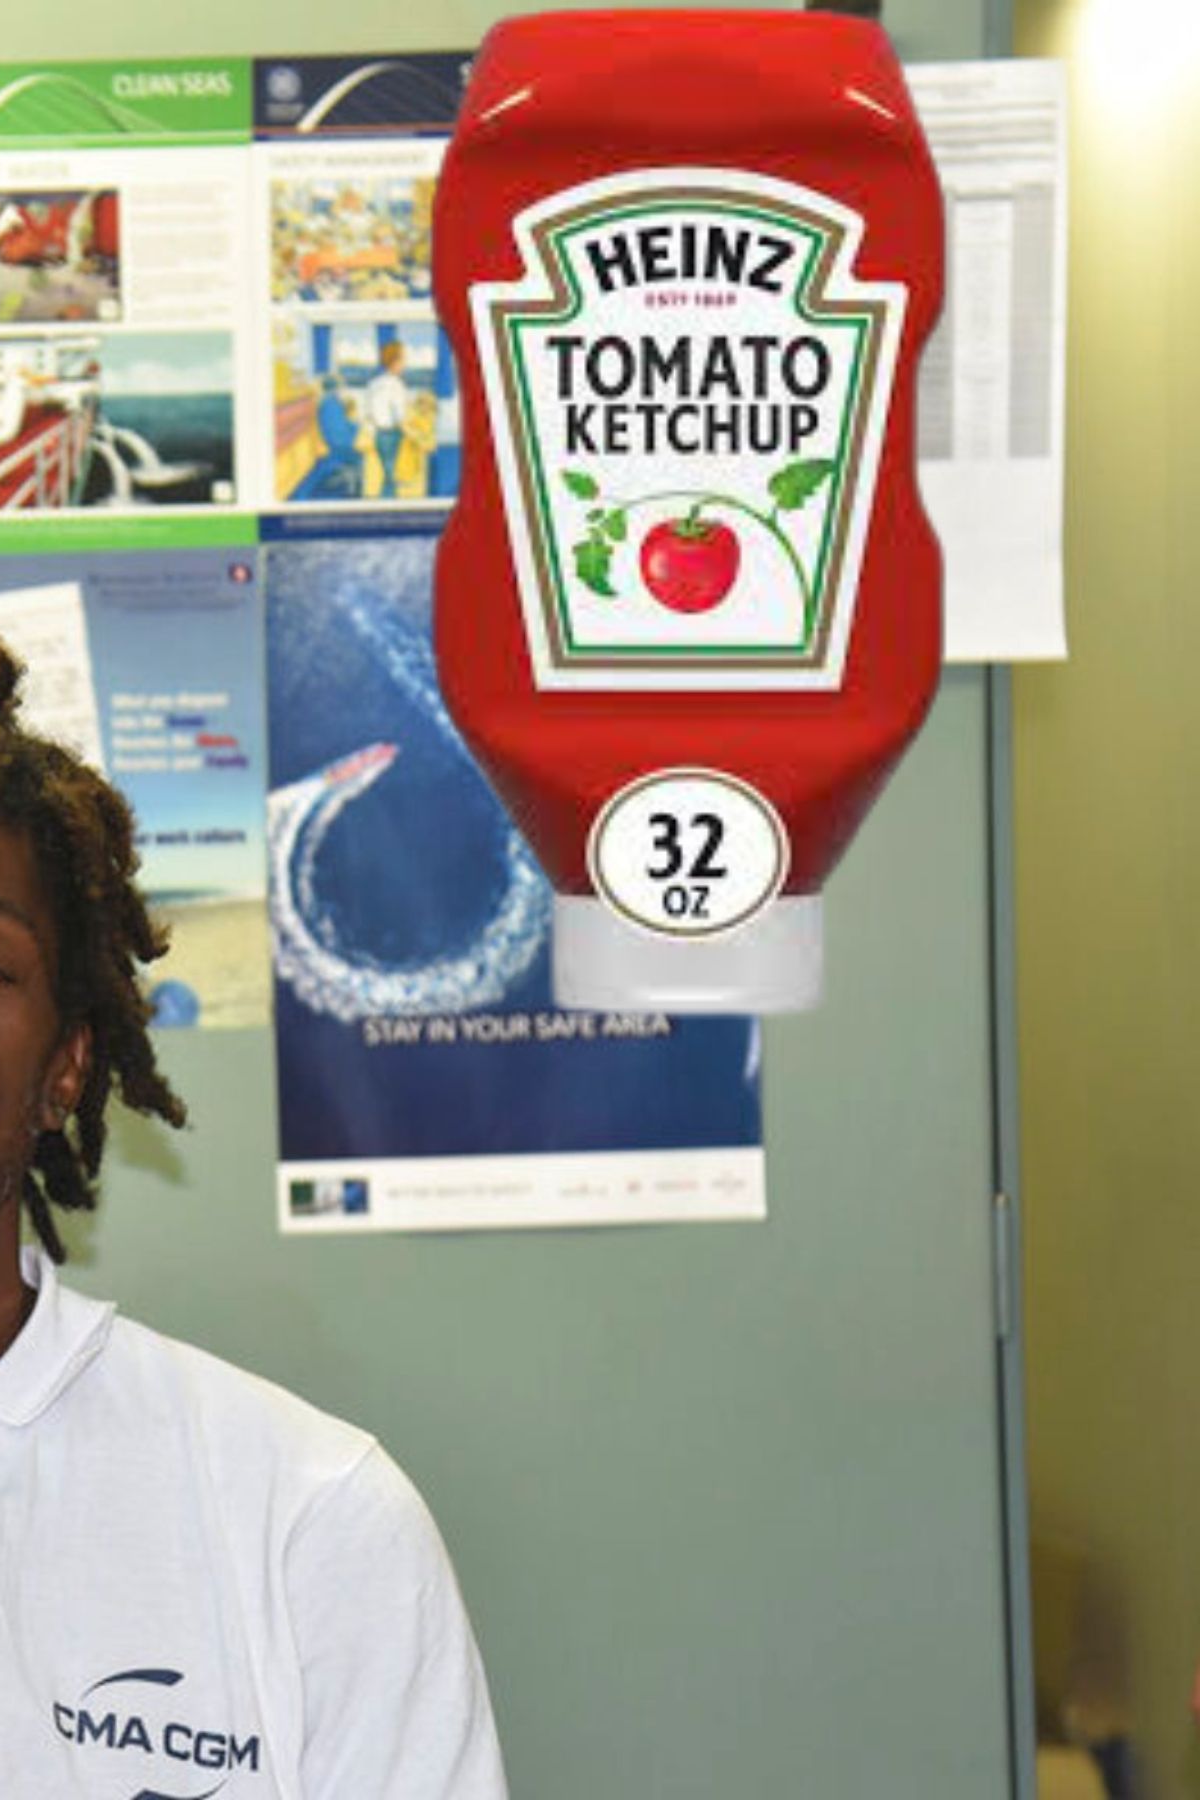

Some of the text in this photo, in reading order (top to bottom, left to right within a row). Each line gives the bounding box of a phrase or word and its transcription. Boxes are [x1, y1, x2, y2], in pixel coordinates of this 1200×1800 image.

[111, 70, 232, 97] CLEAN SEAS
[585, 222, 796, 295] HEINZ
[545, 335, 832, 400] TOMATO
[566, 403, 819, 455] KETCHUP
[647, 812, 729, 880] 32
[662, 885, 710, 918] OZ
[365, 1010, 671, 1046] STAY IN YOUR SAFE AREA
[52, 1700, 260, 1772] CMA CGM
